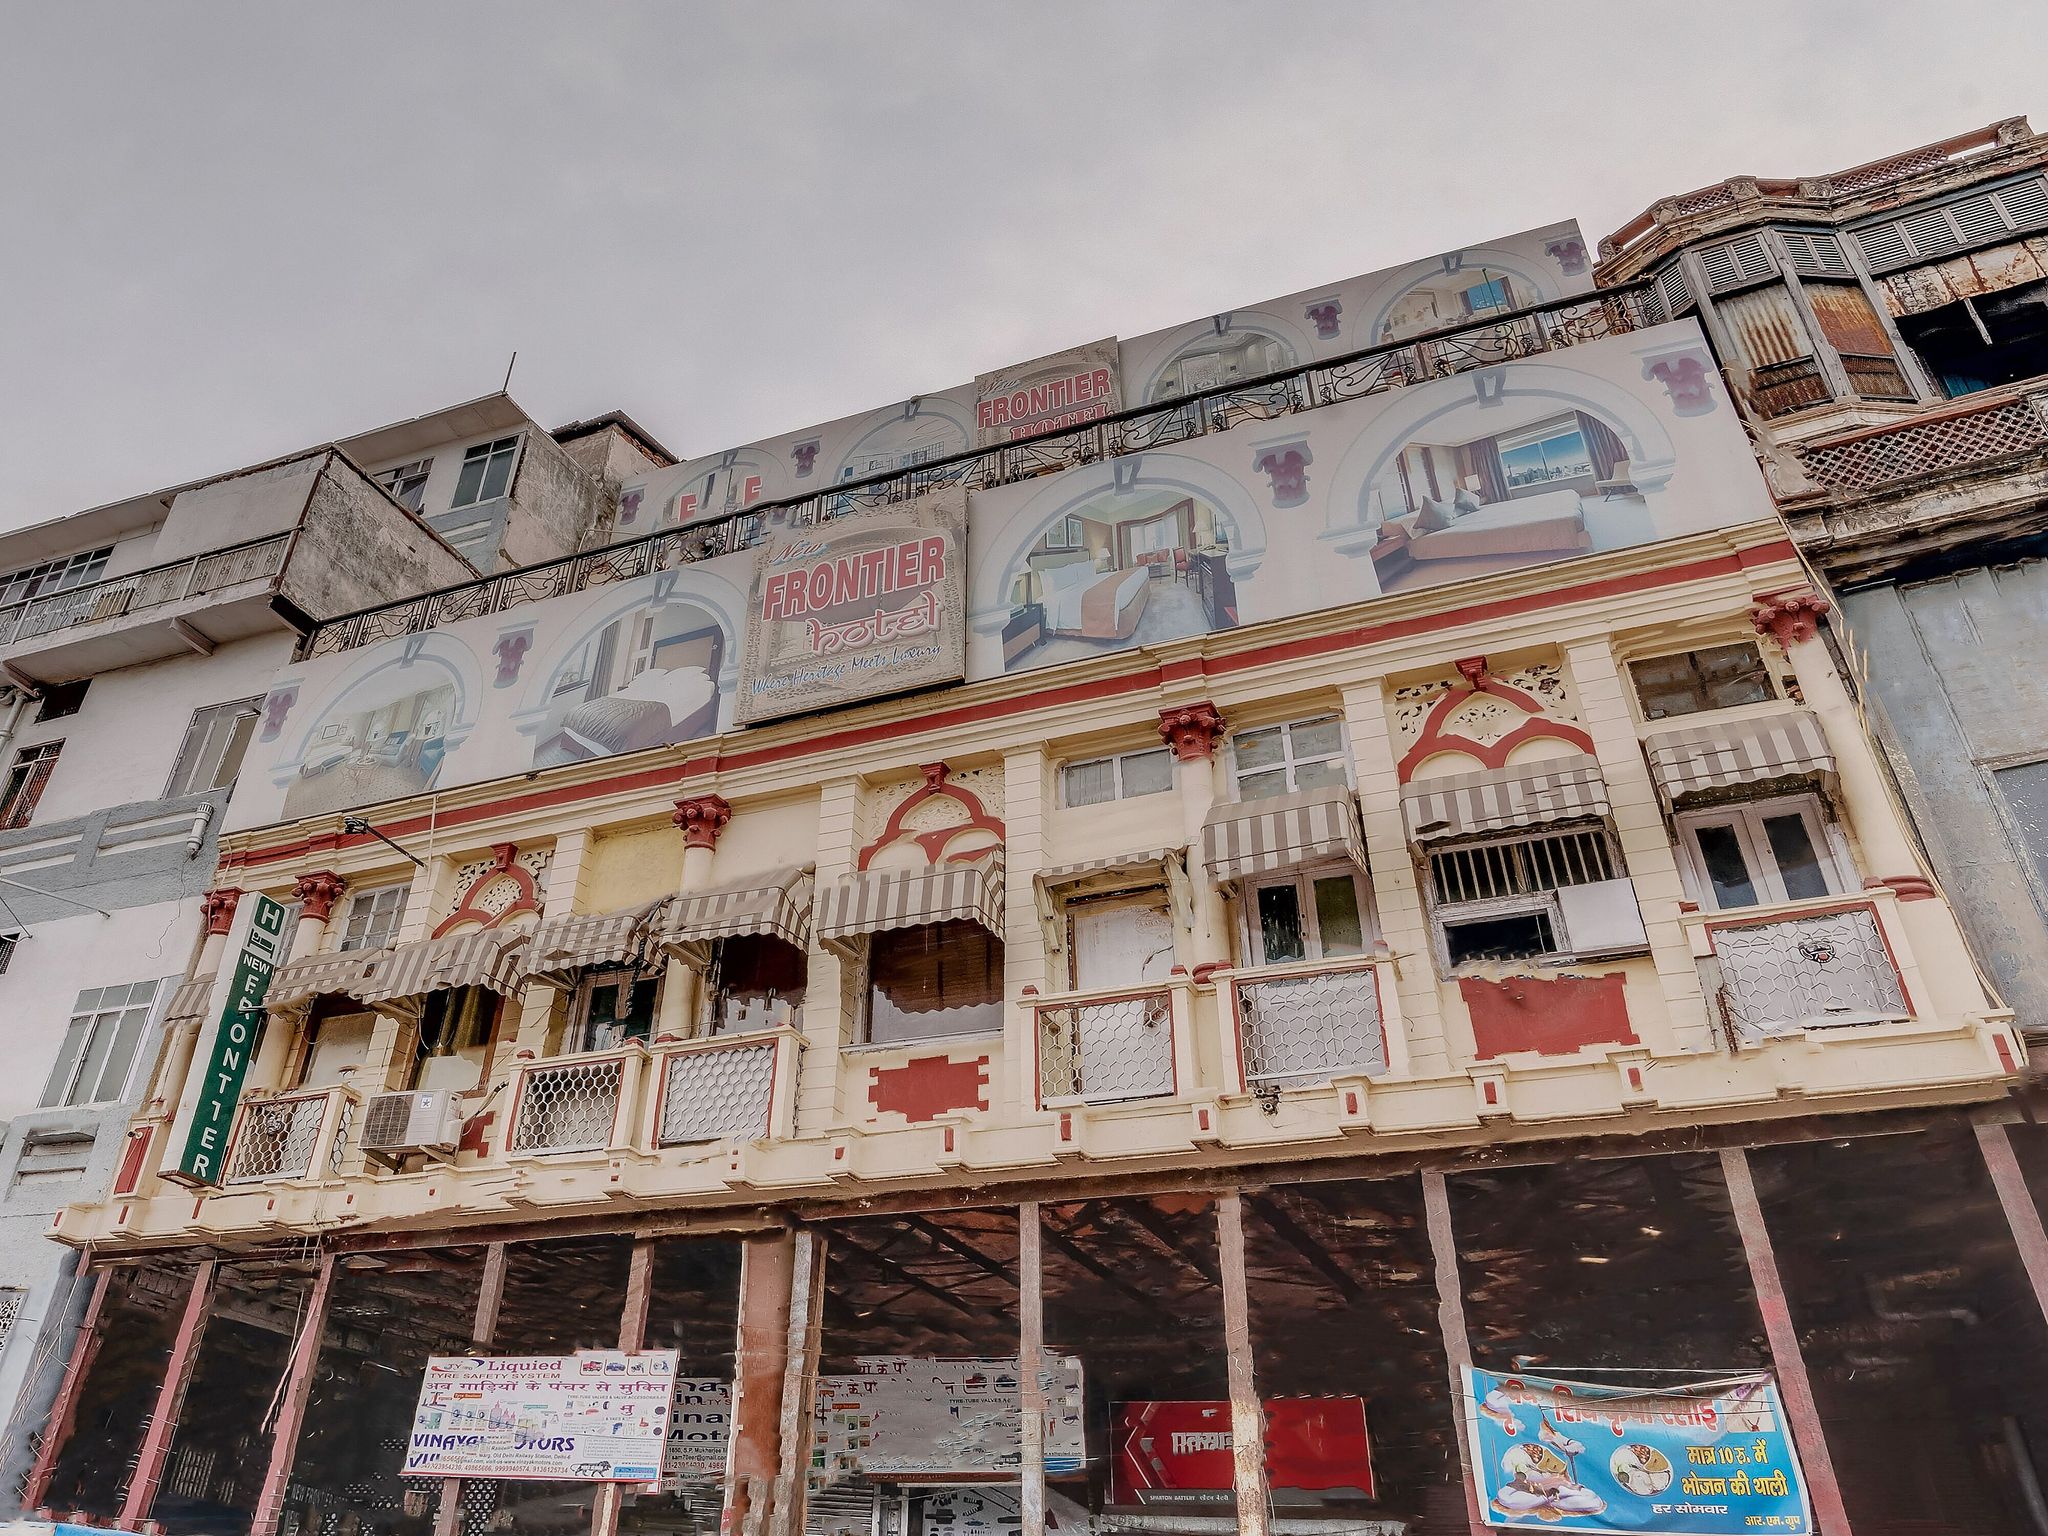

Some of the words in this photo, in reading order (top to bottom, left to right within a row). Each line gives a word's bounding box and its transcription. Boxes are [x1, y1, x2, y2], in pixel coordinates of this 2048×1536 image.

[977, 368, 1111, 430] FRONTIER
[1010, 402, 1108, 440] HOTEL
[762, 536, 946, 621] FRONTIER
[751, 673, 791, 694] Where
[792, 662, 846, 686] Heritage
[850, 652, 887, 670] Meets
[891, 644, 943, 664] Luxury
[243, 956, 270, 976] NEW
[488, 1360, 561, 1375] Liquied
[426, 1382, 453, 1391] अब
[460, 1380, 518, 1393] गाड़ियों
[525, 1381, 541, 1391] के
[548, 1381, 590, 1392] पंचर
[596, 1381, 611, 1392] से
[618, 1380, 668, 1395] मुक्ति
[1685, 1446, 1717, 1465] मात्र
[1718, 1447, 1734, 1464] 10
[1752, 1438, 1768, 1464] में
[1682, 1470, 1728, 1496] भोजन
[1728, 1469, 1752, 1496] की
[1753, 1469, 1789, 1496] थाली
[1652, 1503, 1672, 1515] हर
[1672, 1502, 1729, 1515] सोमवार
